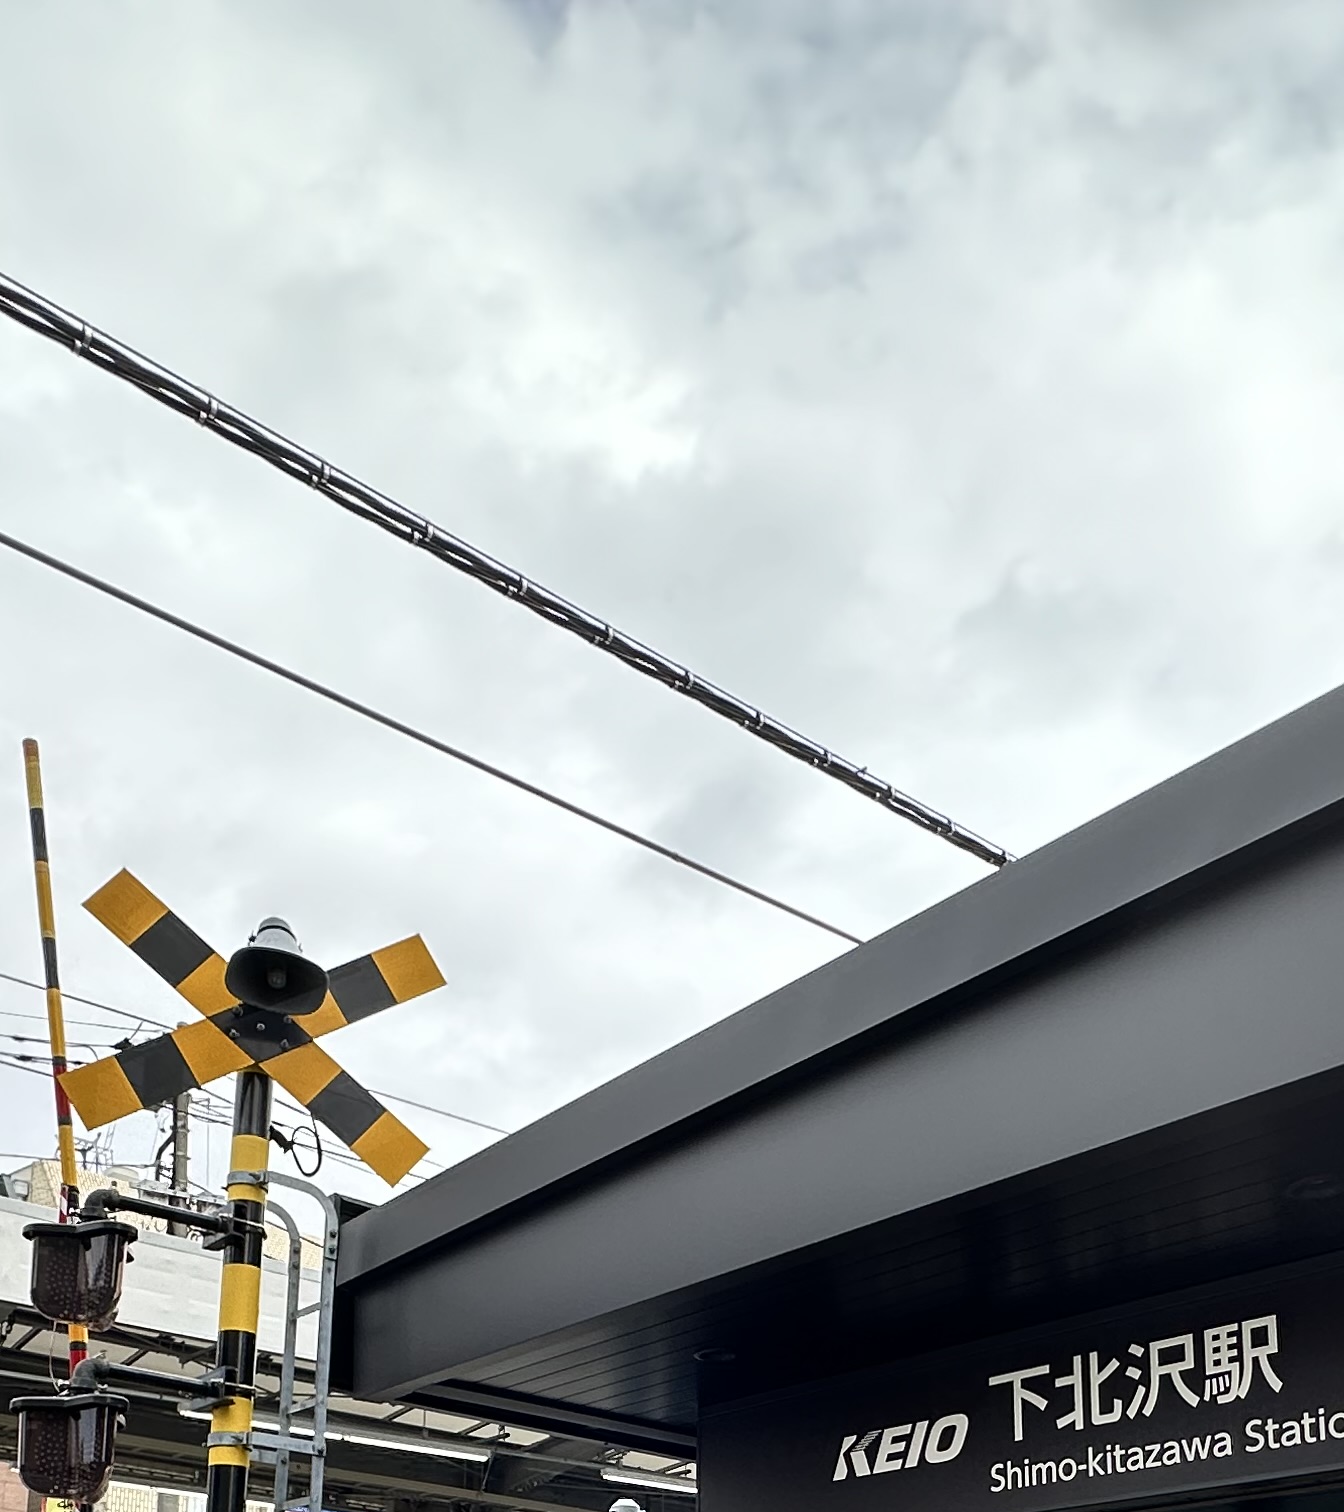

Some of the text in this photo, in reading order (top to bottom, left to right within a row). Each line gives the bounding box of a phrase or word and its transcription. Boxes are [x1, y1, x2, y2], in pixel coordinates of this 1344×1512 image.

[987, 1314, 1284, 1442] 下北沢駅
[832, 1413, 969, 1482] KEIO
[989, 1432, 1233, 1493] Shimo-kitazawa
